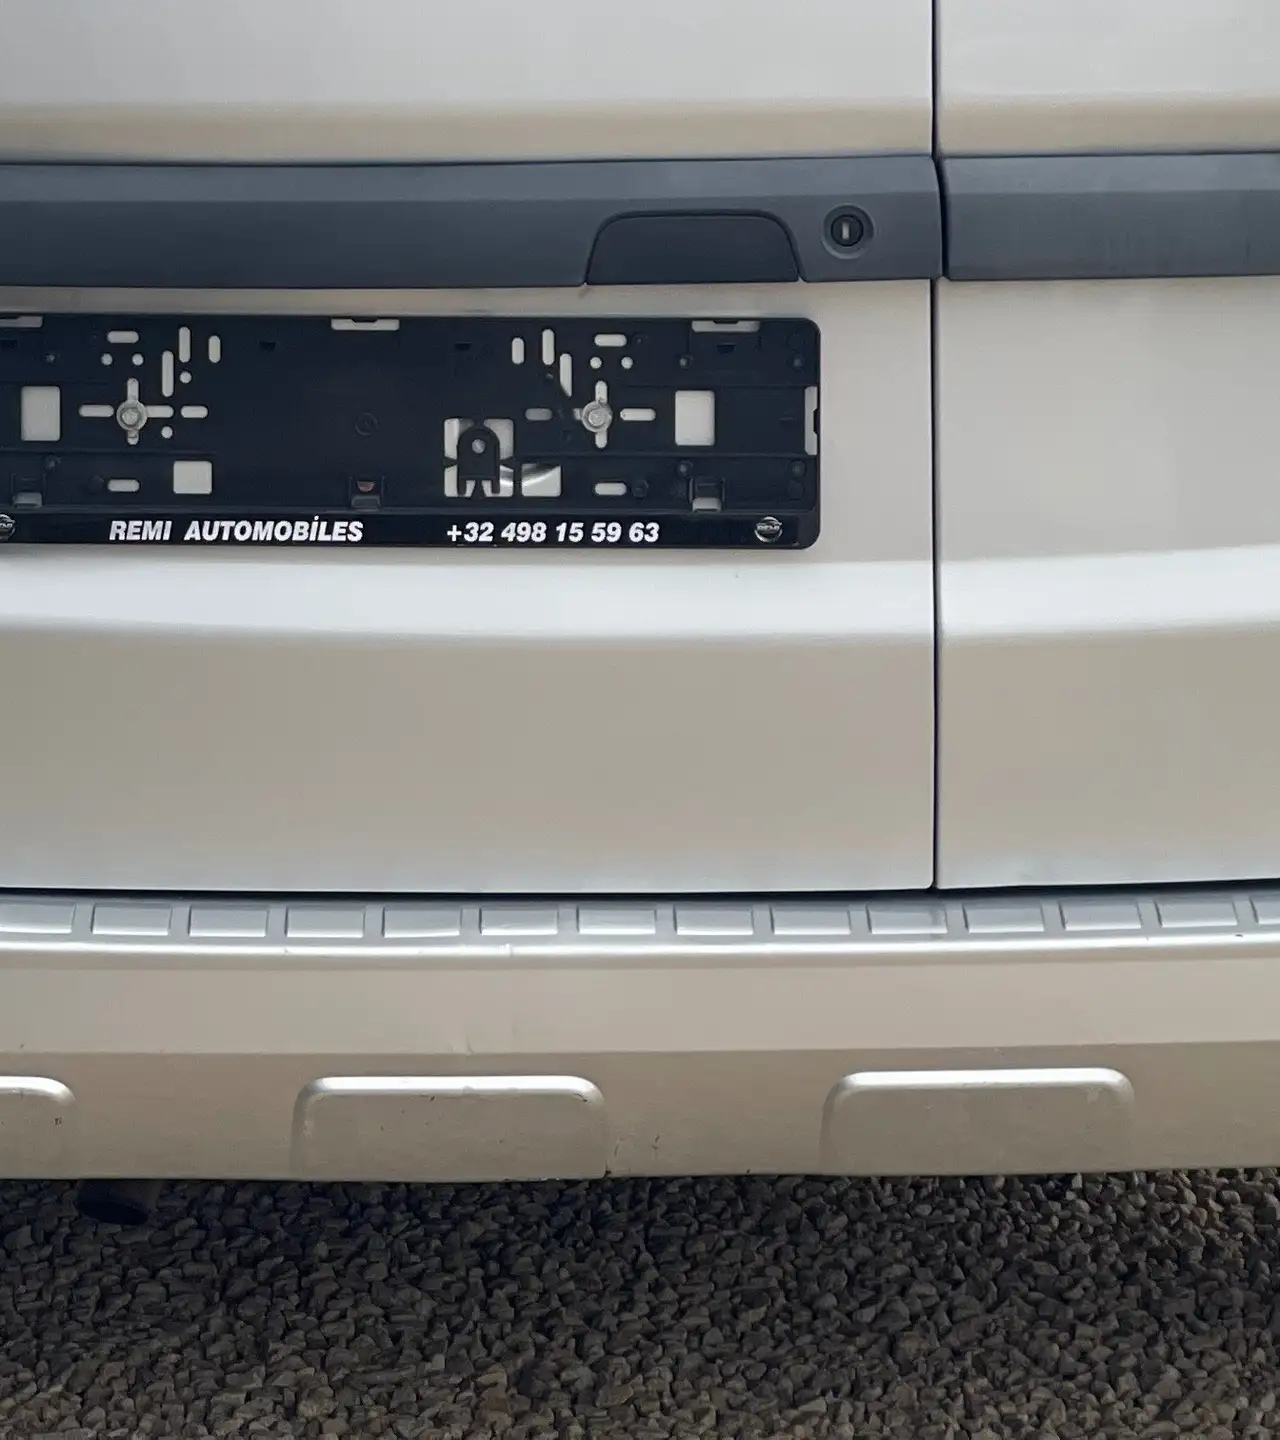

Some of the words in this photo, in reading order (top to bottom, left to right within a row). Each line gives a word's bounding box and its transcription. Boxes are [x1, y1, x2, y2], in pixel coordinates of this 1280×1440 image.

[109, 522, 172, 540] REMI
[446, 523, 494, 543] +32
[501, 523, 547, 543] 498
[556, 522, 584, 542] 15
[591, 522, 622, 542] 59
[629, 522, 660, 542] 63
